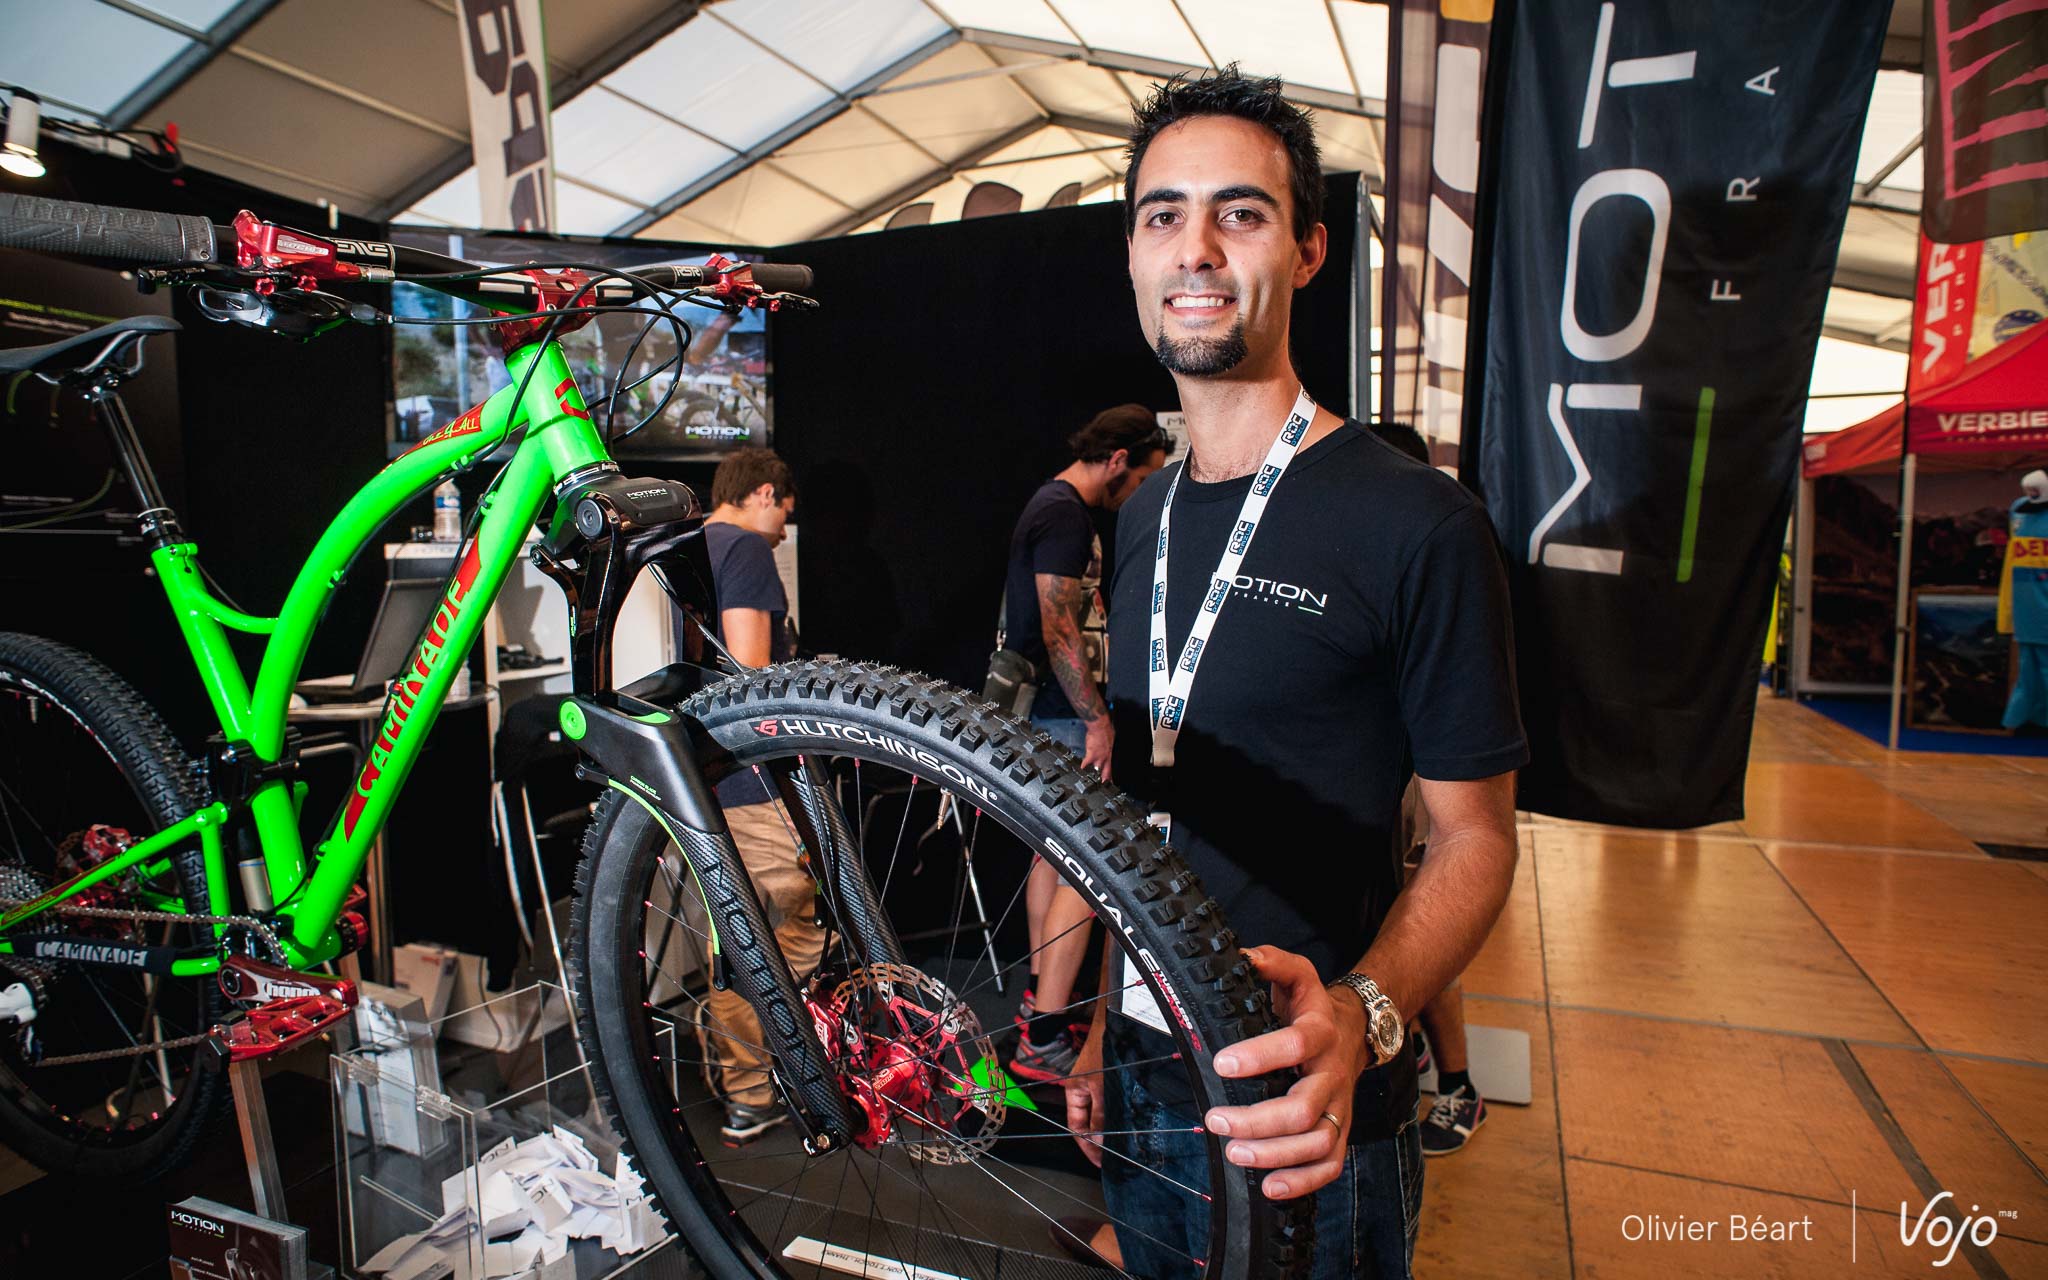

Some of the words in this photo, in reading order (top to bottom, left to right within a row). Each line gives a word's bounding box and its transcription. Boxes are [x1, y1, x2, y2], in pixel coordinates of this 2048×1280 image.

[685, 426, 750, 436] MOTION
[1281, 413, 1303, 445] ROC
[626, 488, 668, 499] MOTION
[1253, 464, 1276, 495] ROC
[1230, 520, 1250, 555] ROC
[1205, 580, 1225, 612] ROC
[1210, 572, 1328, 608] OTION
[1180, 637, 1199, 671] ROC
[1161, 696, 1178, 729] ROC
[1044, 837, 1160, 974] SQUALE
[703, 861, 822, 1086] MOTION
[171, 1210, 225, 1234] MOTION
